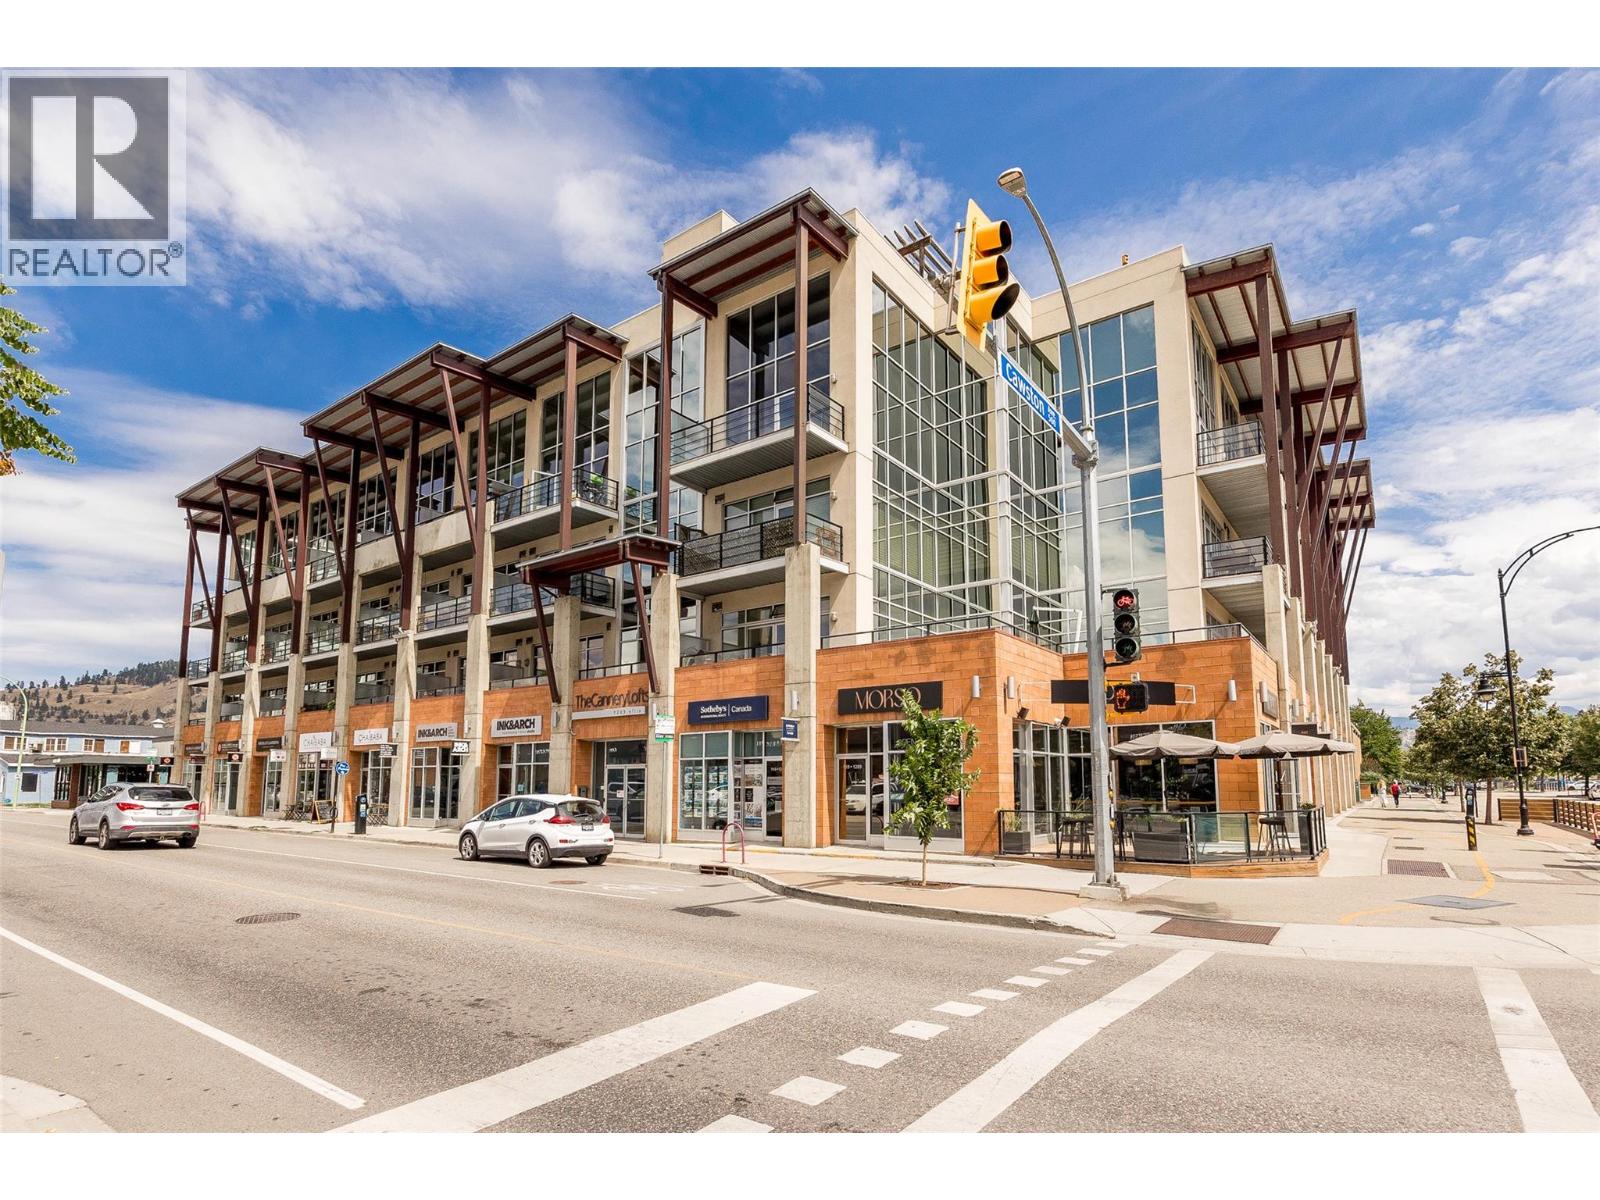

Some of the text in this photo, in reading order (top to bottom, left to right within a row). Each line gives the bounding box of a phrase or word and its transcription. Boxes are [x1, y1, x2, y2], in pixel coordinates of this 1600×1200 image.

[1006, 363, 1045, 416] Cawston
[855, 686, 921, 710] MORSO
[700, 704, 752, 715] Sotheby's Canada
[496, 718, 536, 731] INK&ARCH
[417, 728, 448, 738] INK&ARCH
